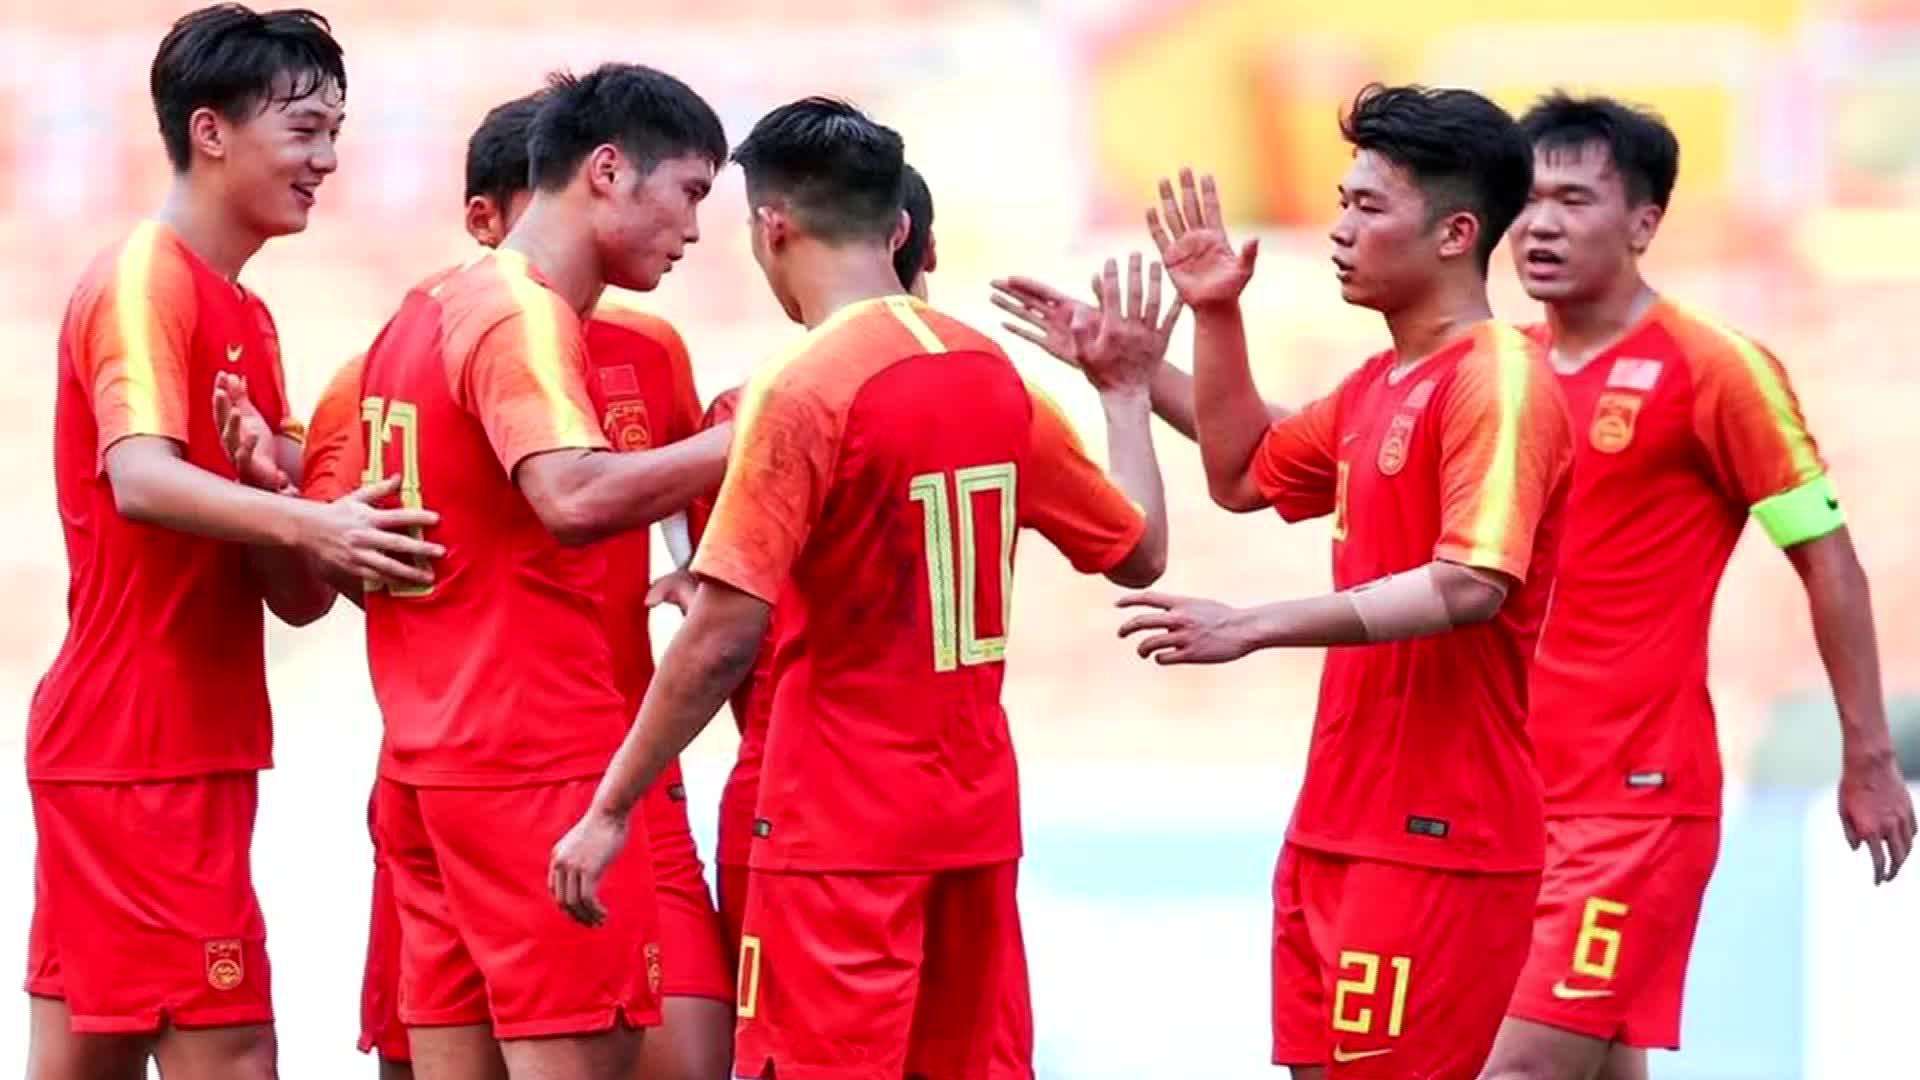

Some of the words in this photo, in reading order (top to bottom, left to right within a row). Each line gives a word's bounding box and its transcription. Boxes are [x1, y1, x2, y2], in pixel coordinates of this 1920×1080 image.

[909, 462, 1017, 672] 10
[1573, 896, 1629, 980] 6
[1333, 951, 1411, 1037] 21
